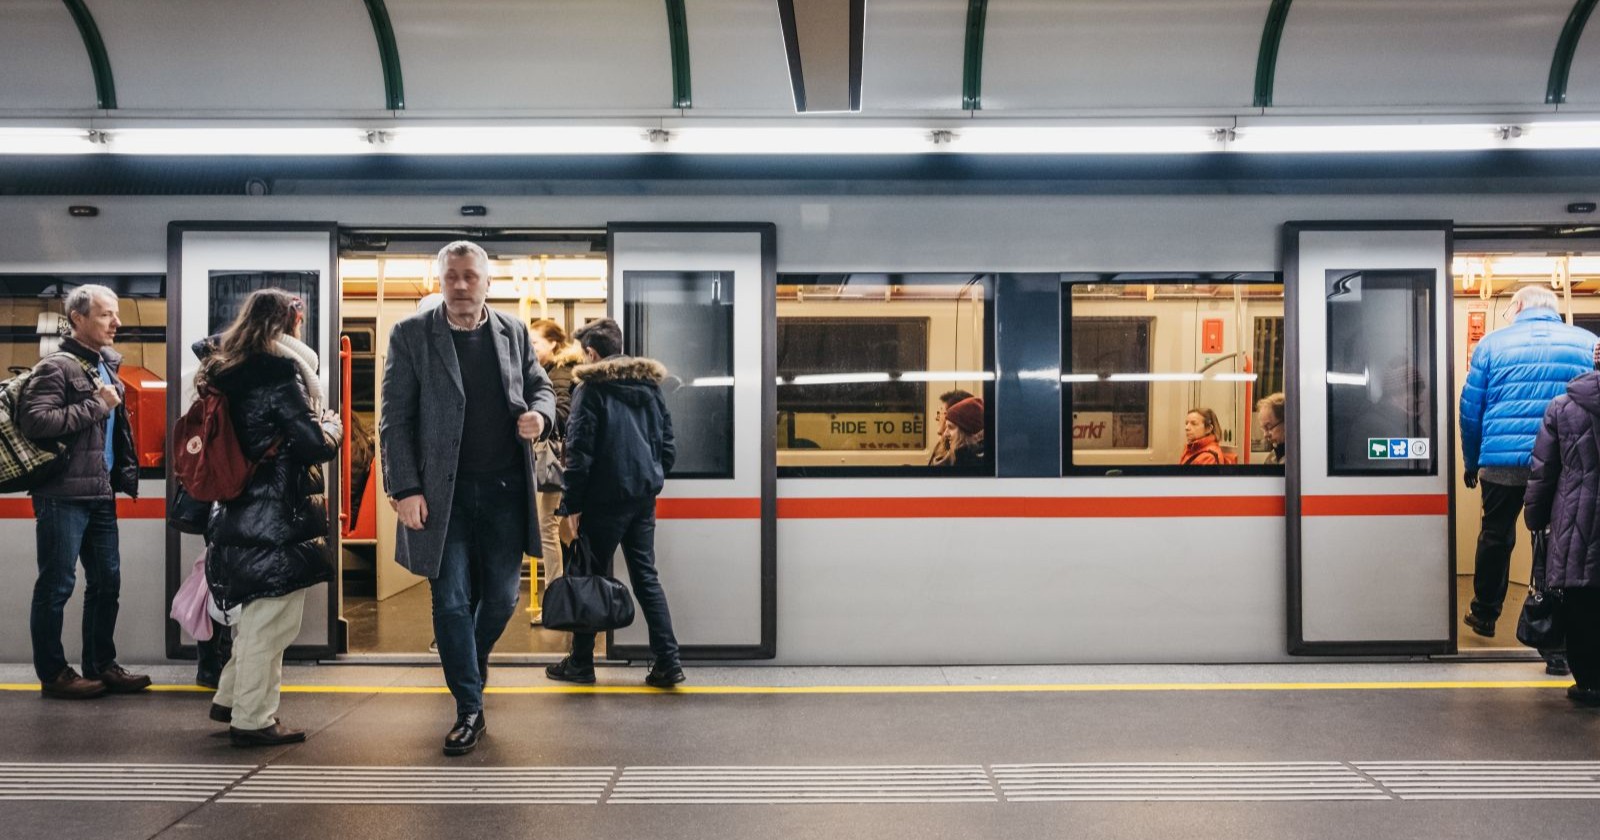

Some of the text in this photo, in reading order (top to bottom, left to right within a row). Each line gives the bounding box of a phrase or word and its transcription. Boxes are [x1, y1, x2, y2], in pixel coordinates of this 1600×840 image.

[830, 420, 923, 434] RIDE TO BE
